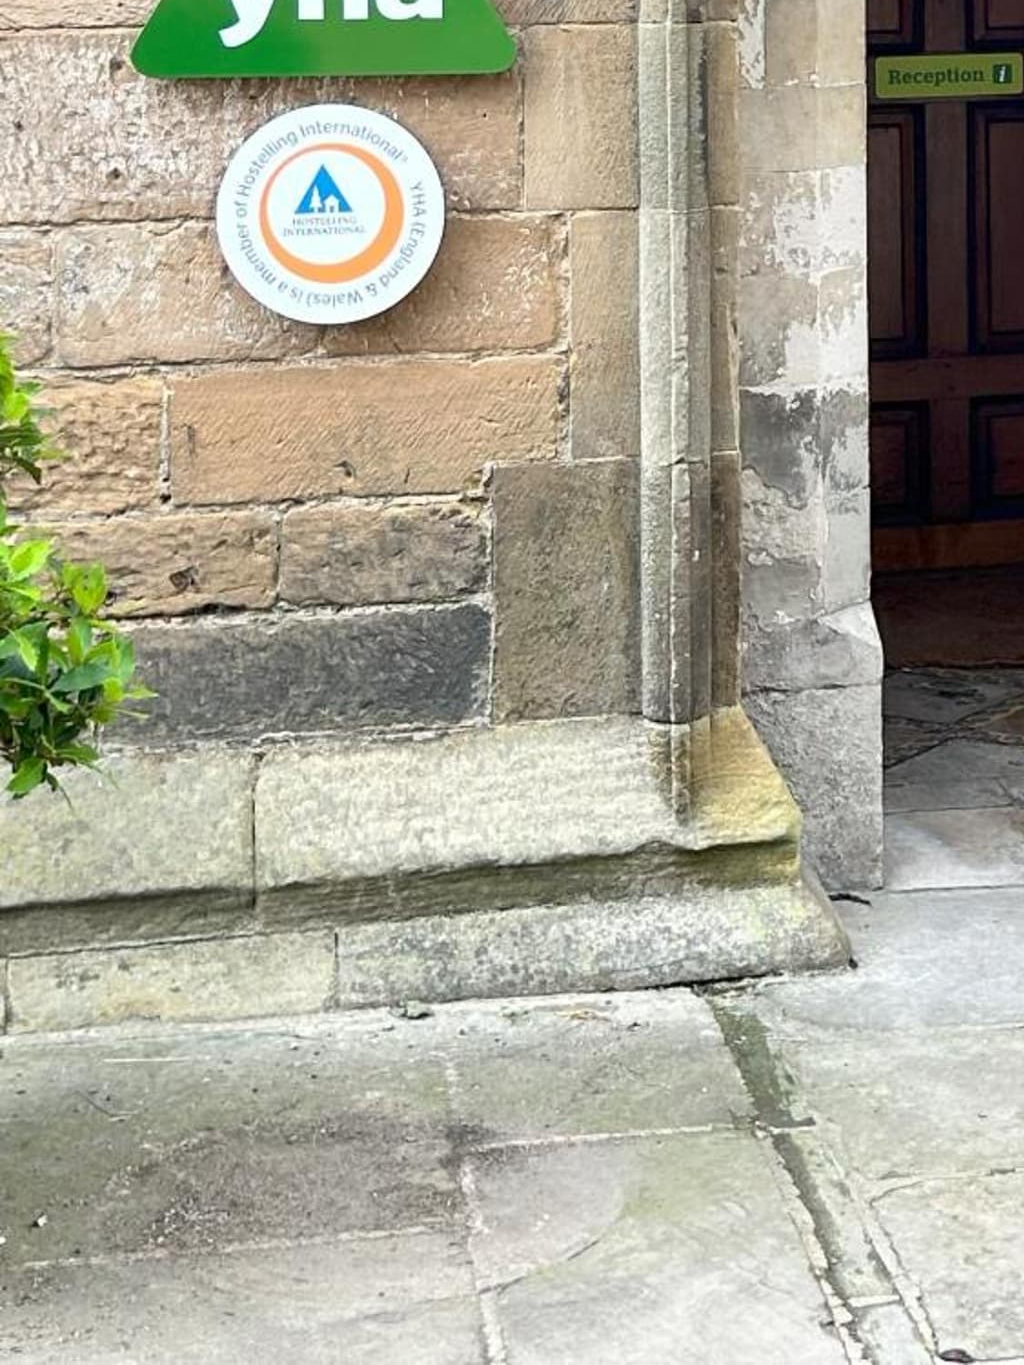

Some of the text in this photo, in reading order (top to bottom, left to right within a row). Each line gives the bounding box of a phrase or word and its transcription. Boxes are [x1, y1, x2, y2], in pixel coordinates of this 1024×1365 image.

[888, 67, 984, 86] Reception
[237, 131, 299, 197] Hostelling
[410, 181, 427, 217] YHA
[234, 201, 248, 219] of
[236, 221, 277, 288] member
[381, 222, 425, 288] (England
[278, 282, 287, 294] a
[289, 287, 303, 303] is
[365, 283, 379, 297] &
[306, 290, 364, 309] Wales)
